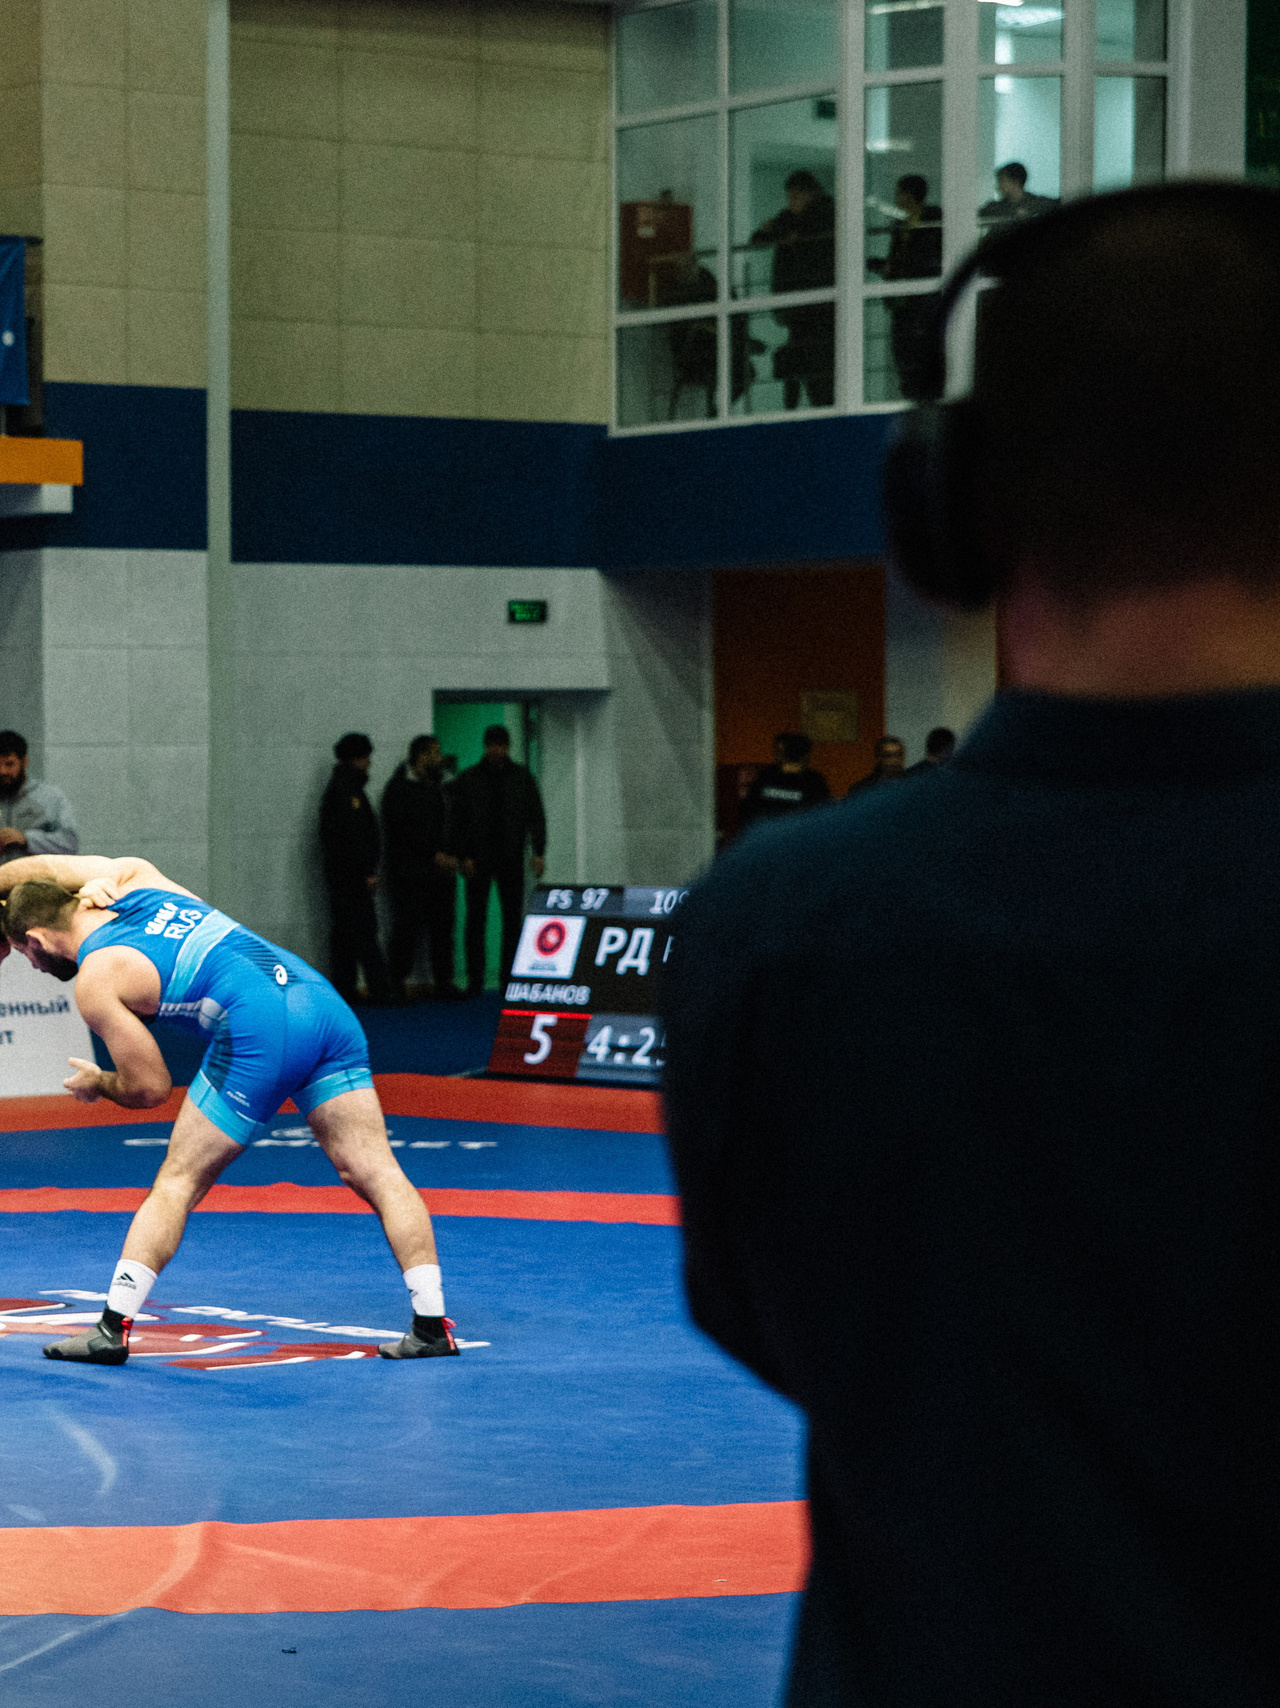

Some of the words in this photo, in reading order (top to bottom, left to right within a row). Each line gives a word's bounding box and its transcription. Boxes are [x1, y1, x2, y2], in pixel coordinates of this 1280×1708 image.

[546, 888, 574, 910] FS
[580, 888, 610, 910] 97
[163, 909, 203, 939] RUS
[594, 926, 655, 976] РД
[504, 982, 591, 1005] ШАБАНОВ
[523, 1013, 558, 1065] 5
[586, 1025, 667, 1068] 4:2
